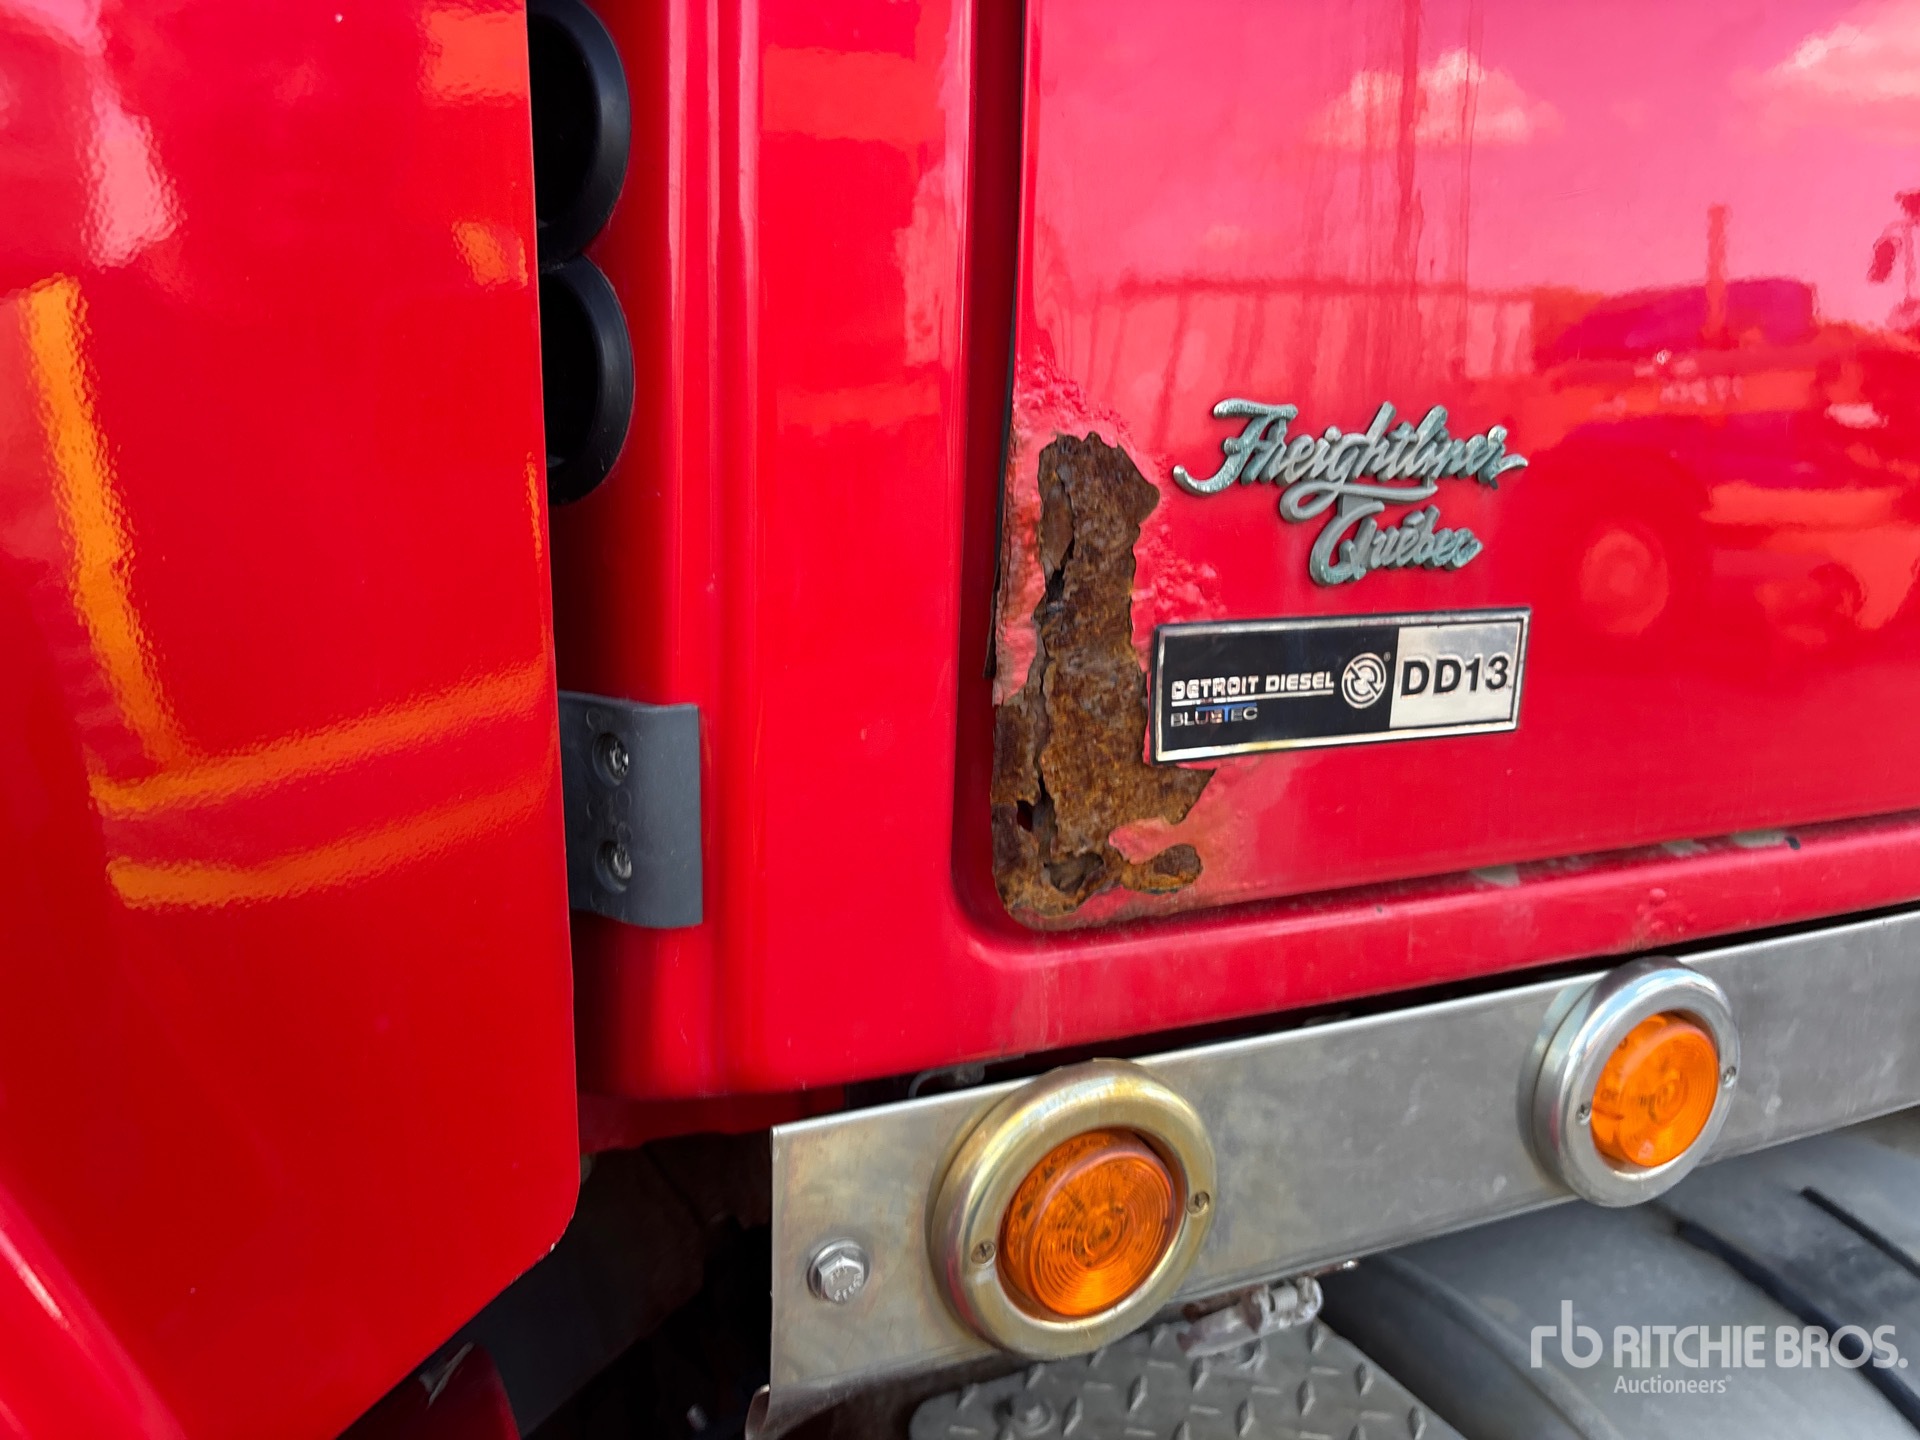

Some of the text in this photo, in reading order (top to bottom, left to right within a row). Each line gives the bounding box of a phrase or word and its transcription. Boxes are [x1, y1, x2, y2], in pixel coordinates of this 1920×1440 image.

[1173, 398, 1528, 522] Freightliner
[1171, 671, 1335, 700] DETROIT DIESEL
[1400, 653, 1510, 697] DD13
[1170, 703, 1258, 727] BLUETEC
